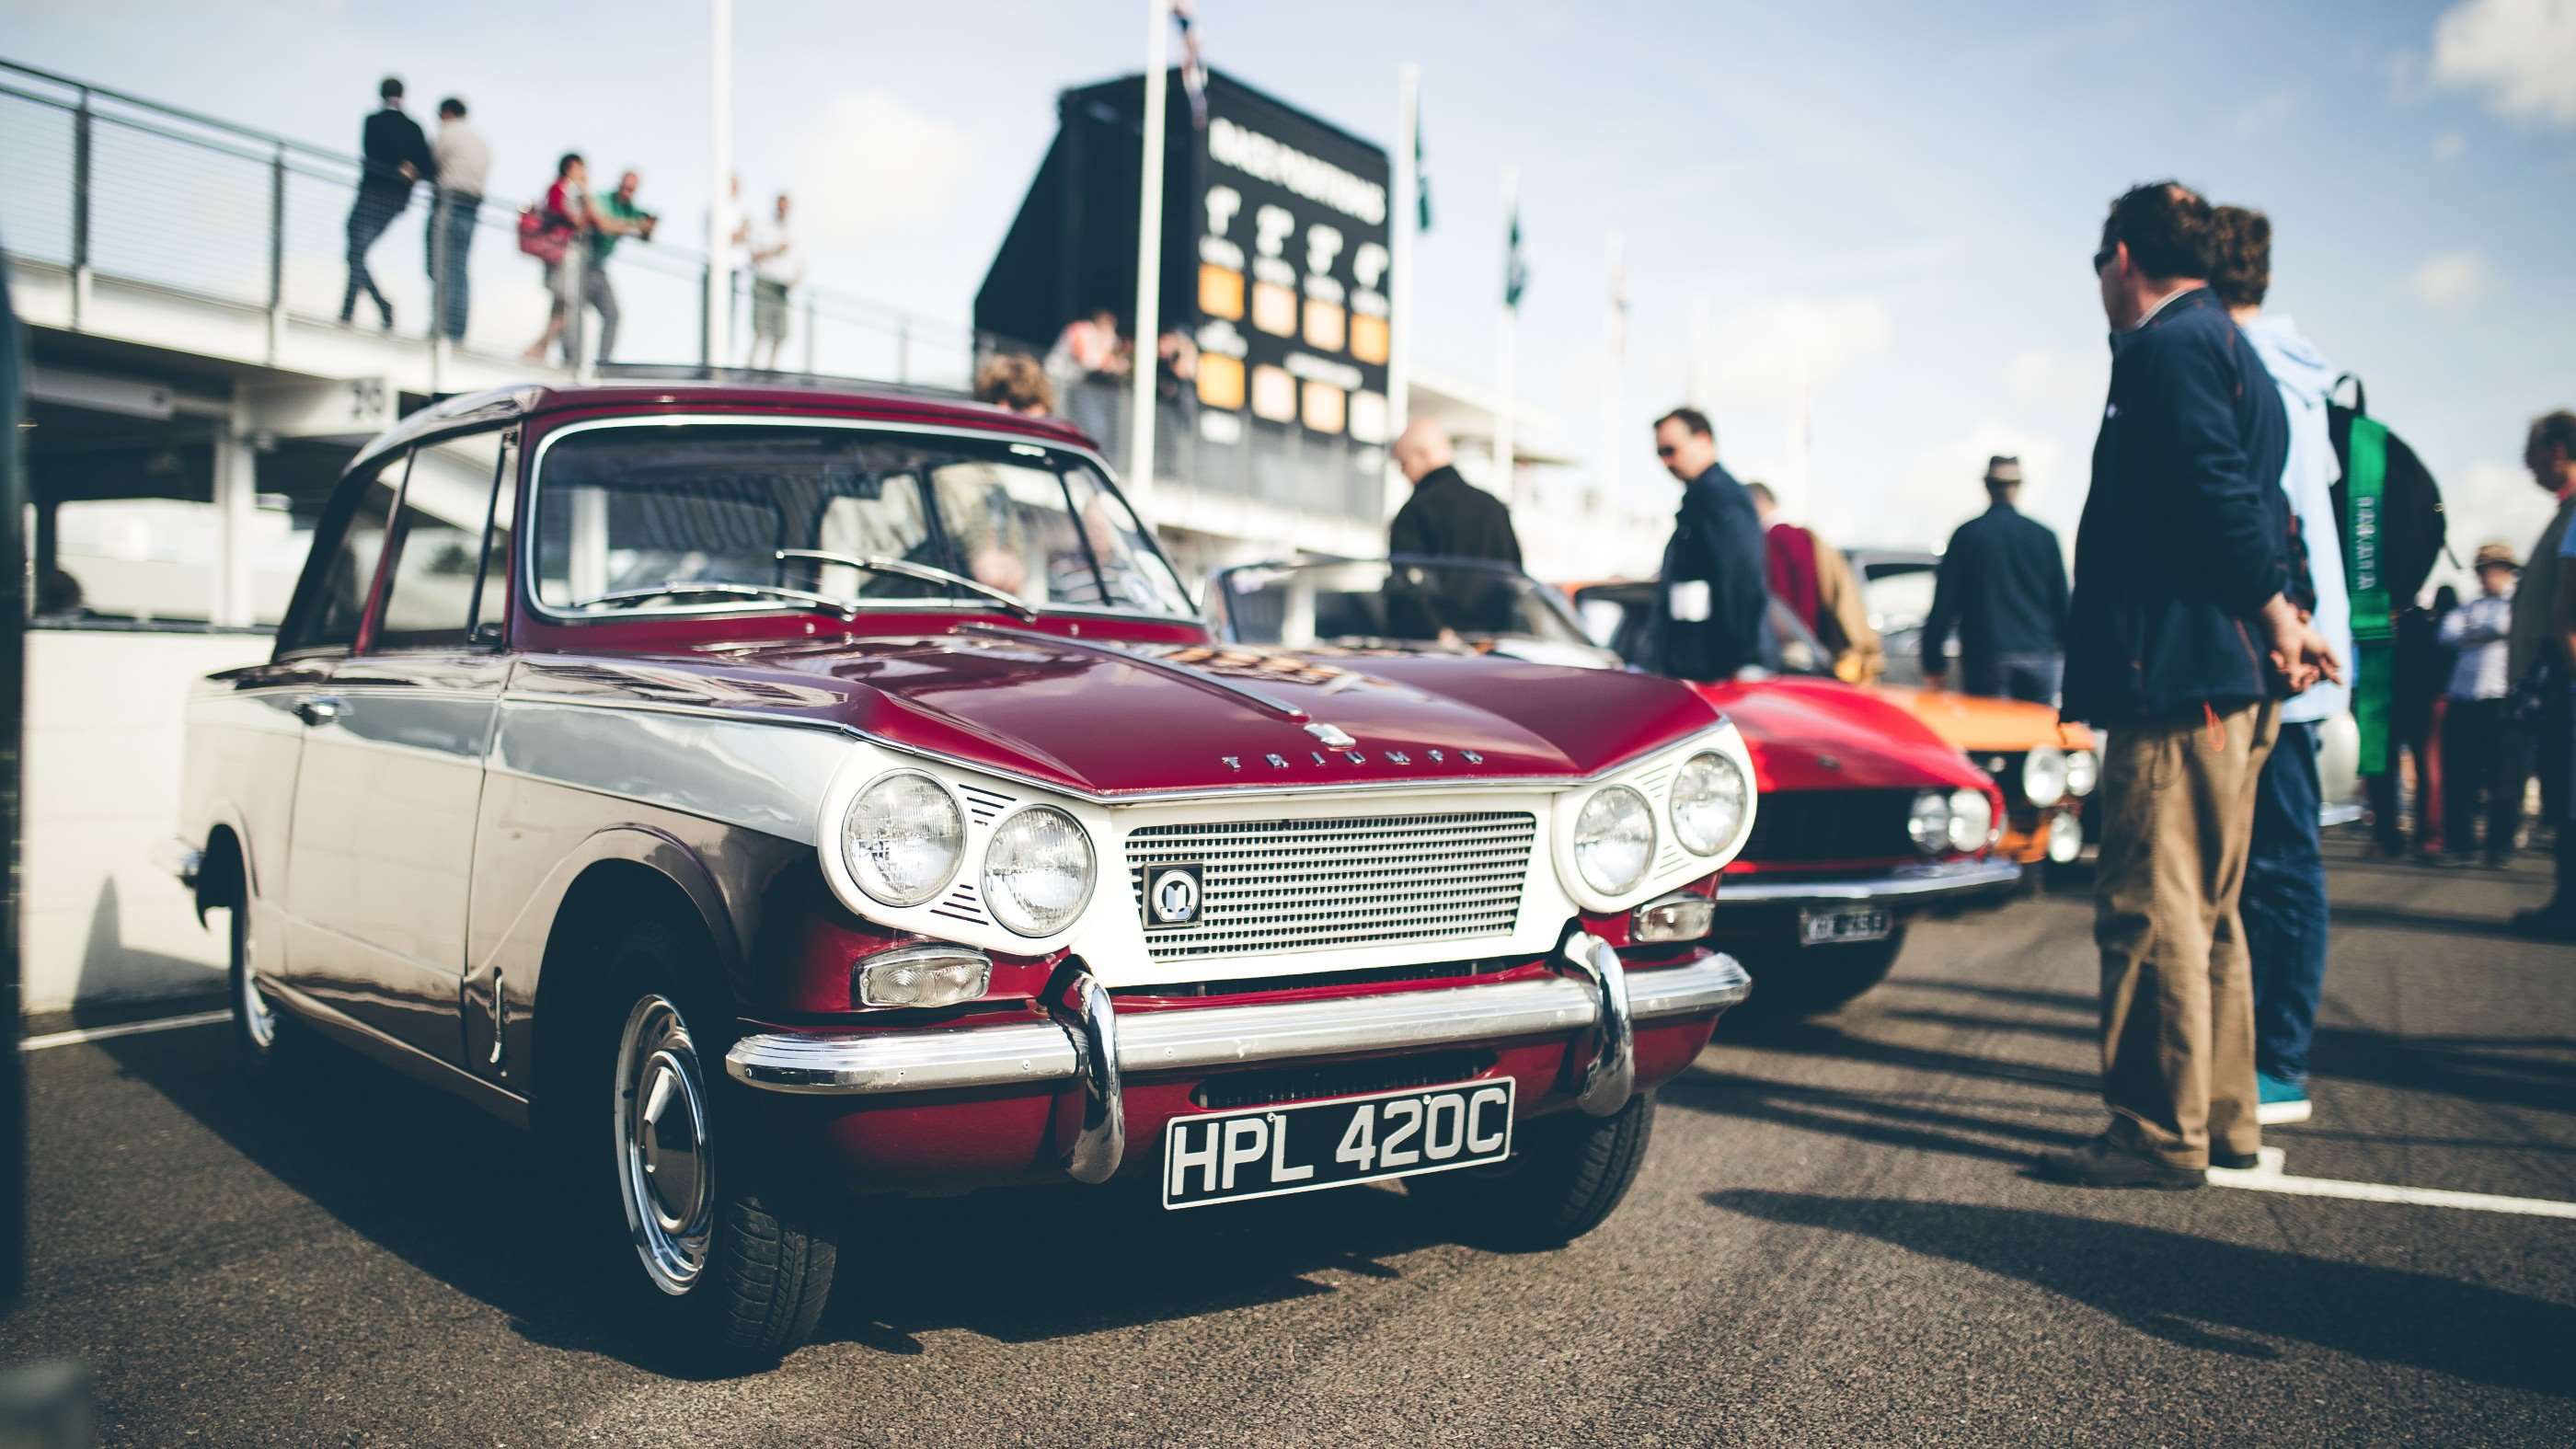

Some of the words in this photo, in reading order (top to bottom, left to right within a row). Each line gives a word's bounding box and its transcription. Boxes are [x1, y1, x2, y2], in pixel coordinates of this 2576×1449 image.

[1222, 748, 1484, 772] TRIUMPH
[1170, 1114, 1314, 1196] HPL
[1335, 1087, 1507, 1171] 420C
